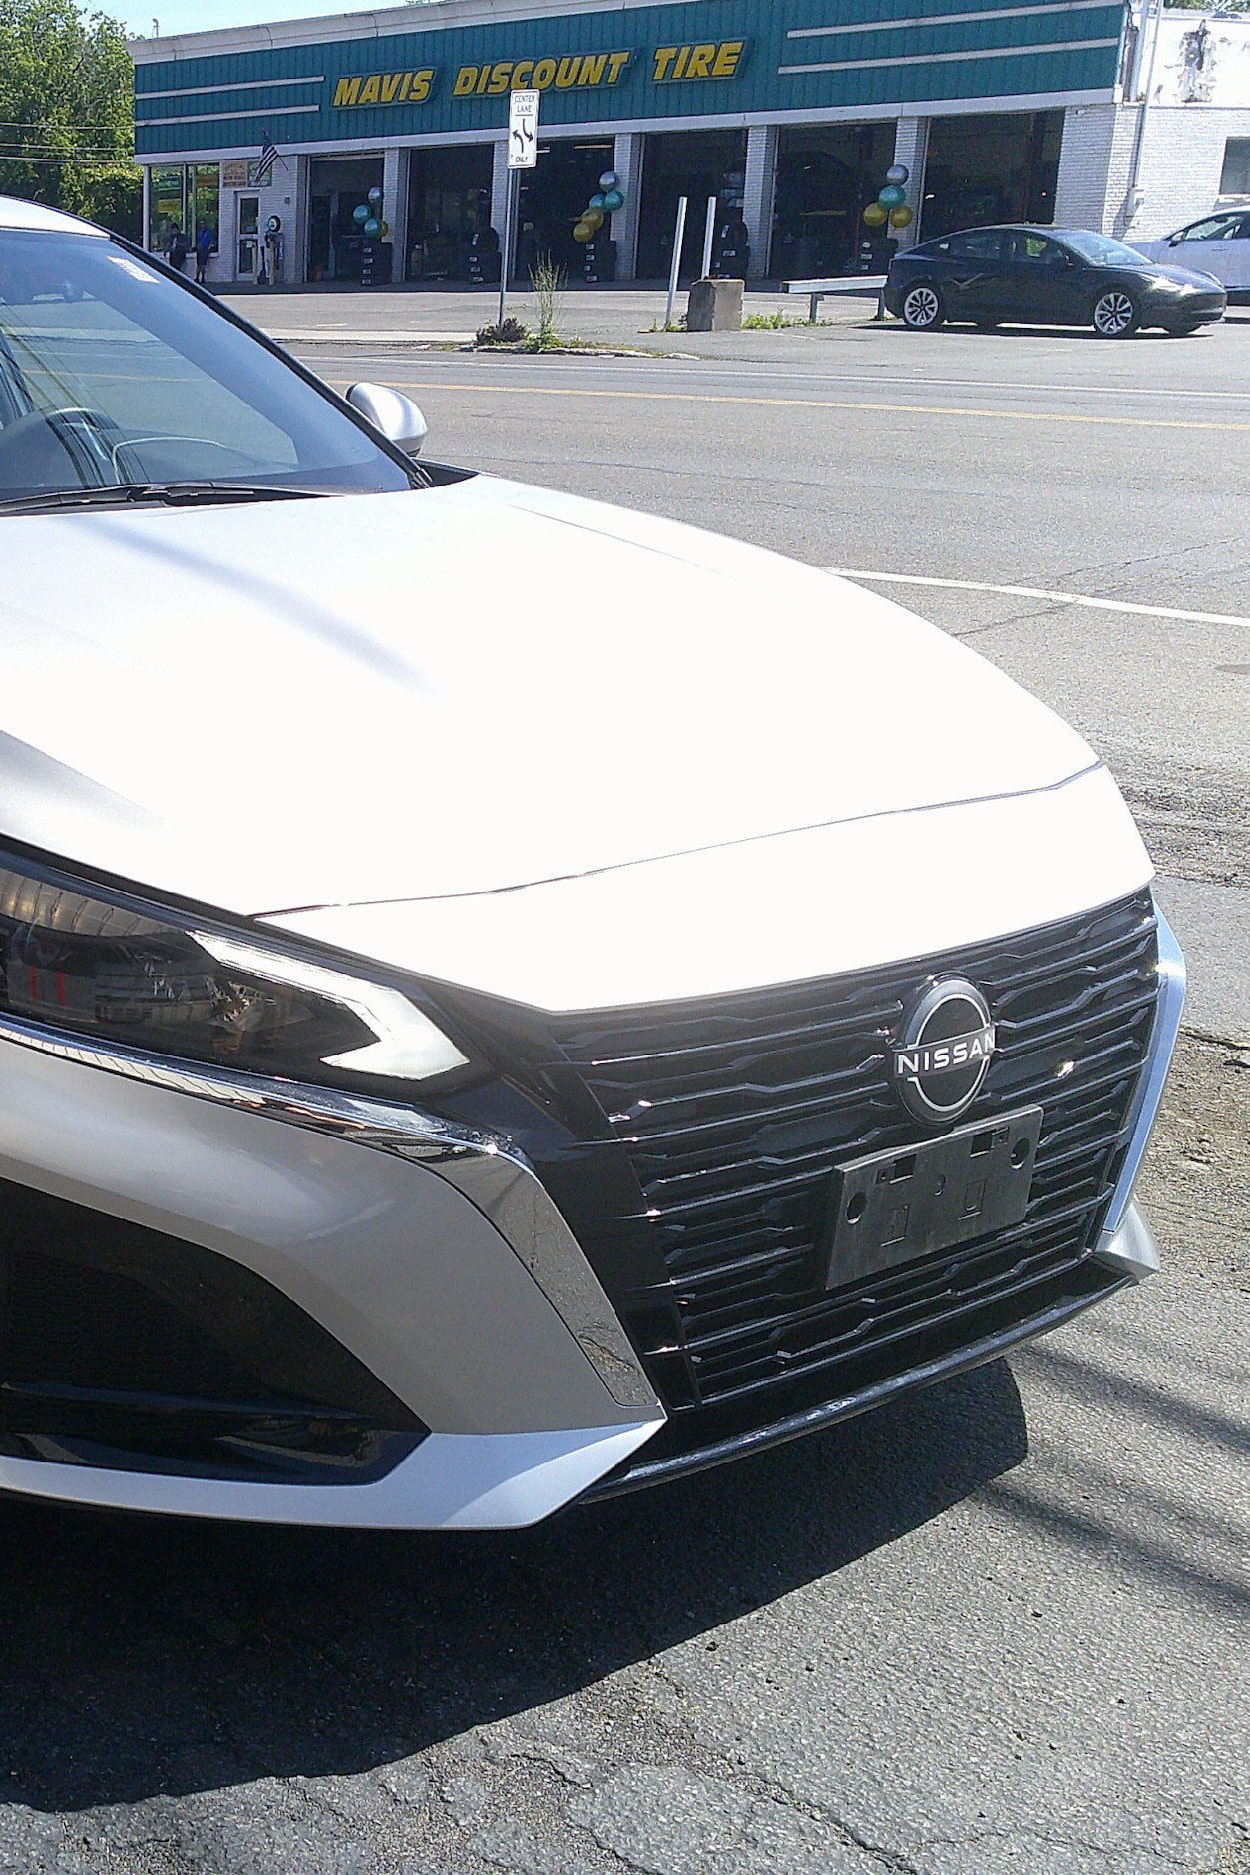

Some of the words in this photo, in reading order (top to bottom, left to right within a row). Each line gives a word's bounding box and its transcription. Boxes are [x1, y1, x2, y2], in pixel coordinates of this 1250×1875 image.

[333, 70, 434, 107] MAVIS
[453, 51, 630, 97] DISCOUNT
[653, 41, 744, 80] TIRE
[514, 95, 535, 103] CENTER
[517, 105, 532, 113] LANE
[898, 1029, 996, 1074] NISSAN
